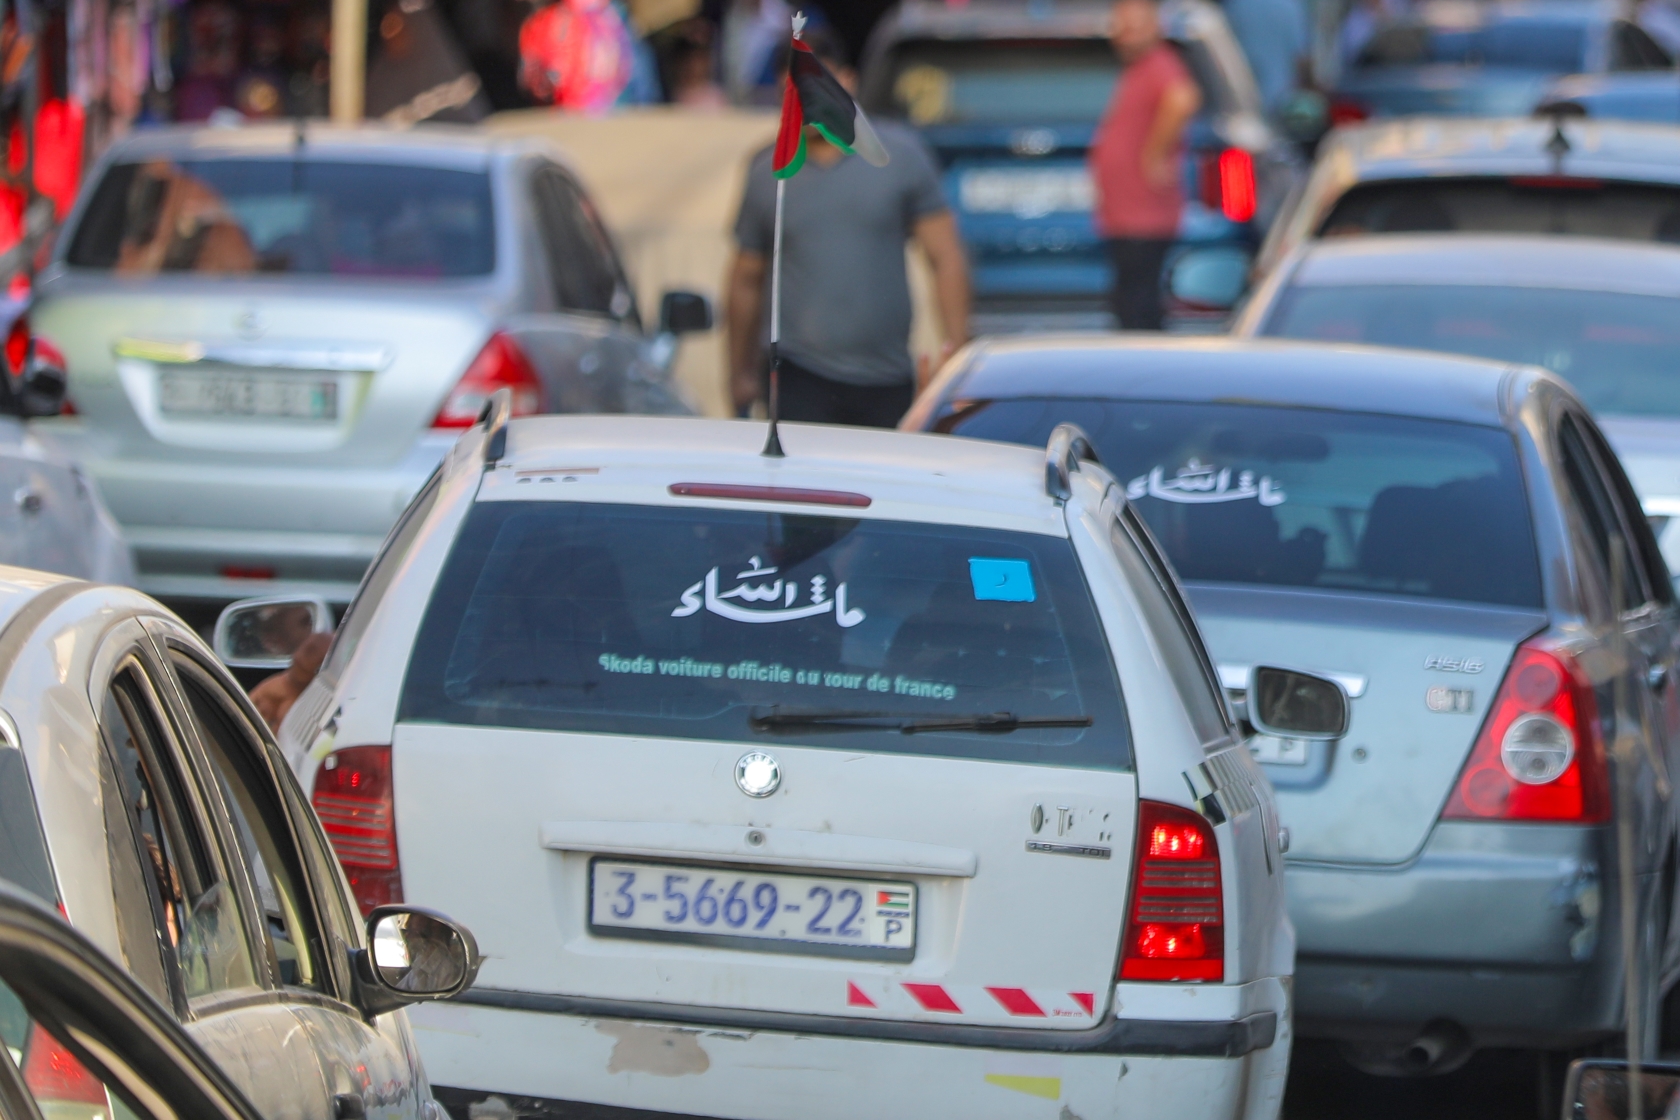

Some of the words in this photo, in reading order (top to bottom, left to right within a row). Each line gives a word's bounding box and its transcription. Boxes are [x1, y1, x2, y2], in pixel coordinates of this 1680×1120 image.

[658, 656, 723, 679] voiture
[866, 670, 892, 693] de
[610, 871, 866, 937] 3-5669-22
[884, 918, 903, 943] P
